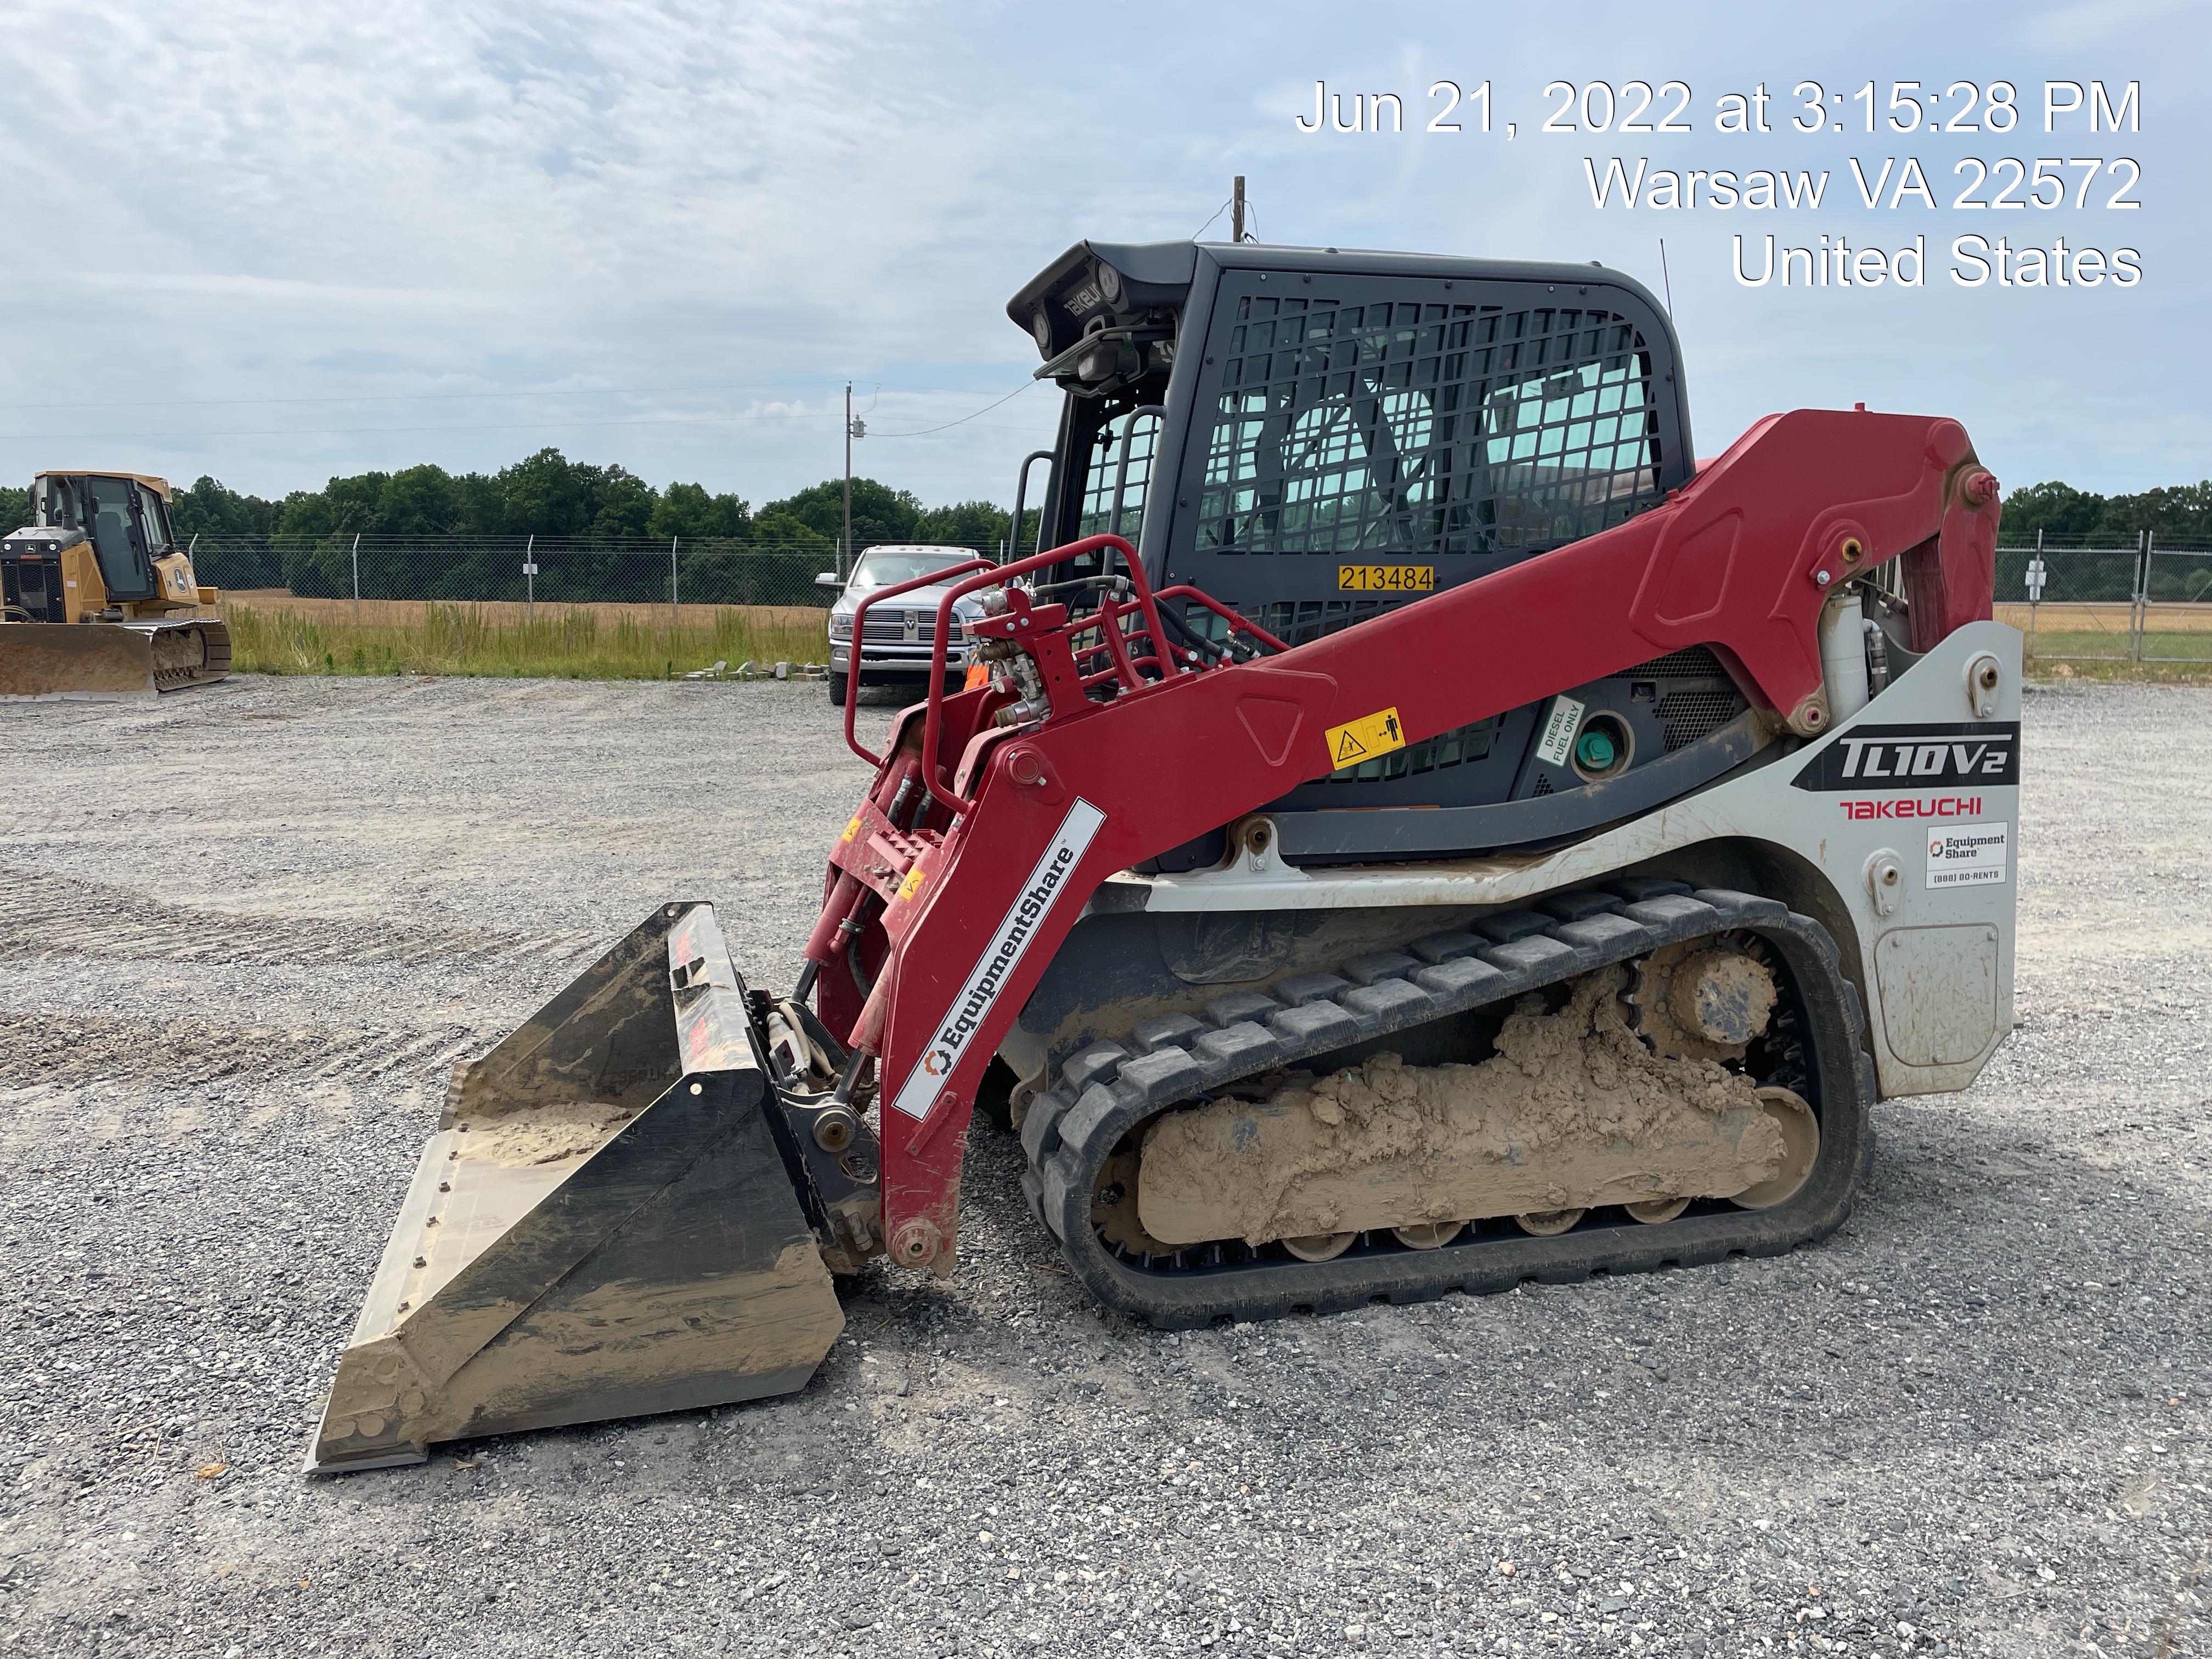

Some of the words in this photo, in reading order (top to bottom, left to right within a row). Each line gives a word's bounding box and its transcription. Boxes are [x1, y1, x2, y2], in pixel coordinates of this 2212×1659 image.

[1341, 567, 1432, 589] 213484
[1545, 712, 1565, 747] DIESEL
[1554, 736, 1569, 761] FUEL
[1564, 704, 1579, 732] ONLY
[1945, 849, 1977, 859] Share
[1946, 834, 2005, 849] Equipment
[940, 847, 1074, 1049] EquipmentShare
